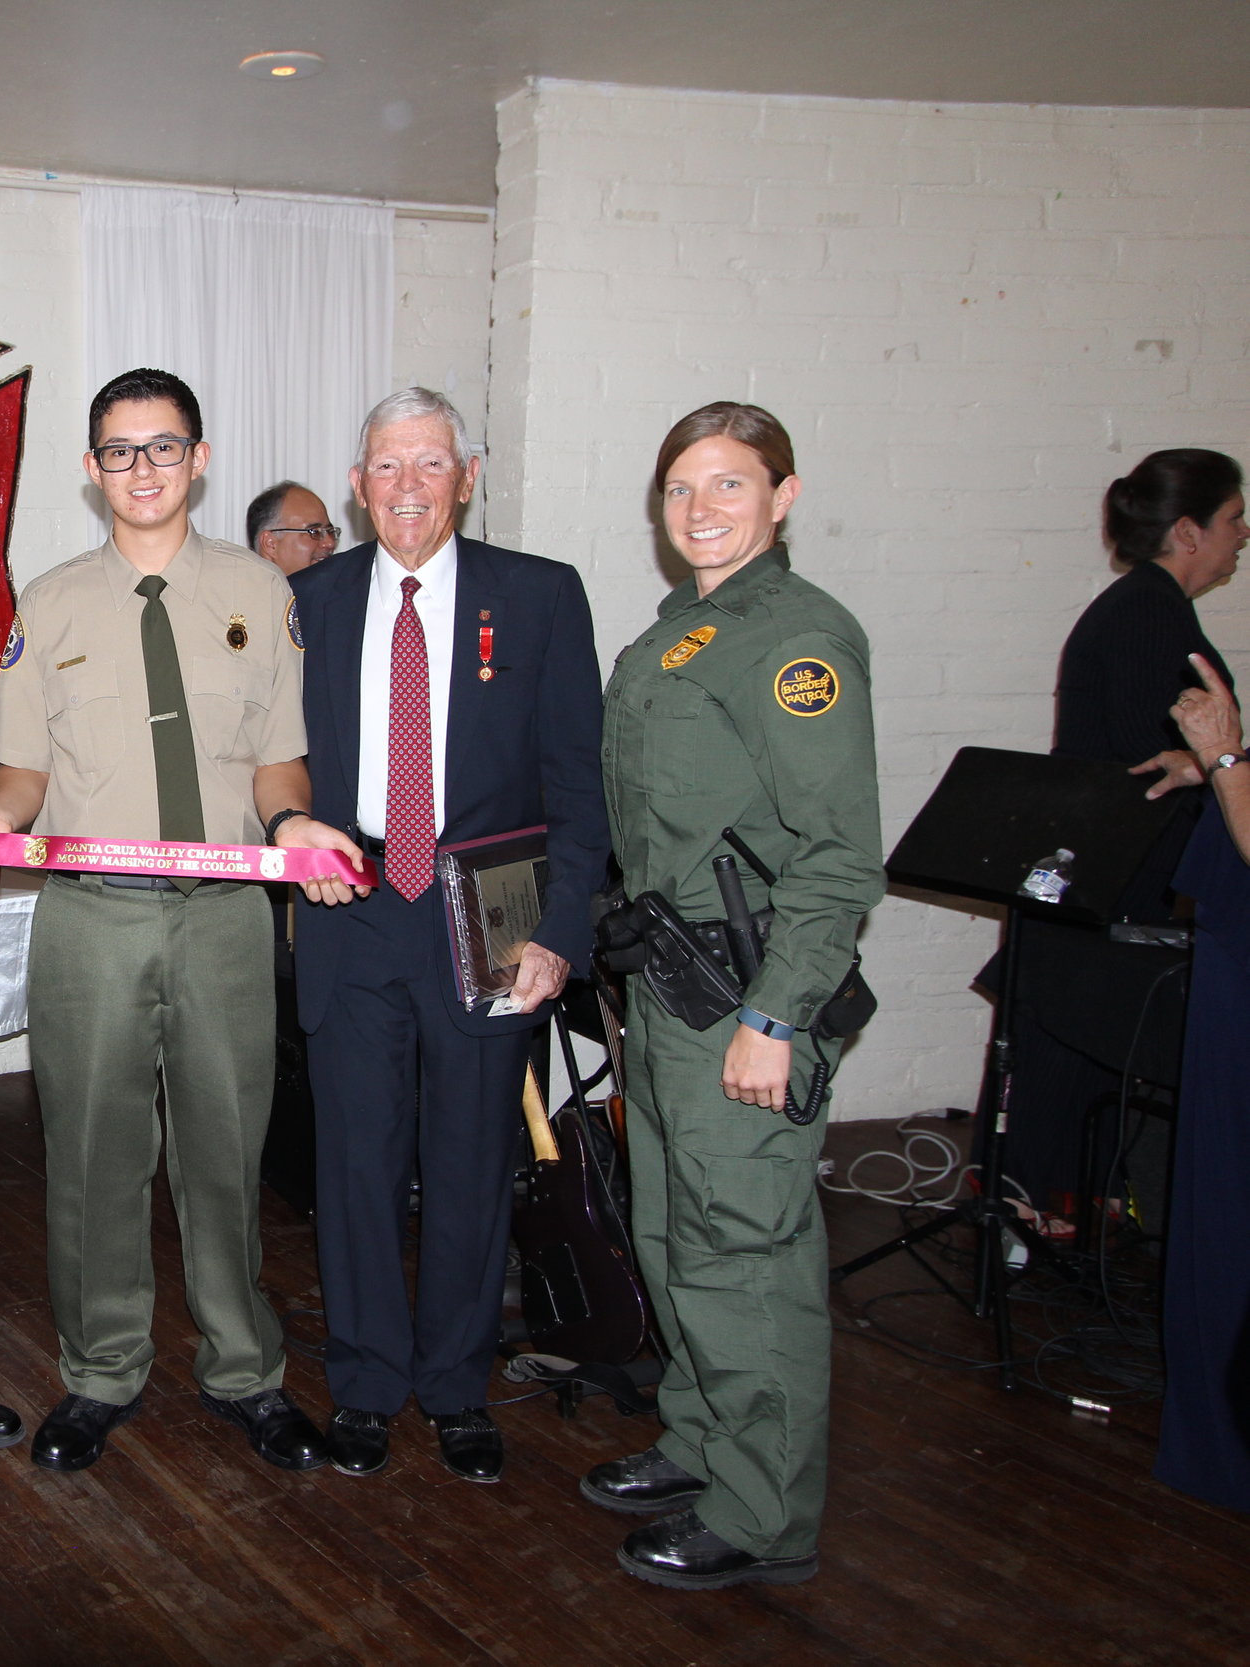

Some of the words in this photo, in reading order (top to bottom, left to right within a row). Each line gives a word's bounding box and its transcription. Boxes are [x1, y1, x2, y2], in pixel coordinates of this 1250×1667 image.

[794, 669, 815, 680] U.S.
[783, 680, 829, 694] BORDER
[786, 689, 831, 704] PATROL
[64, 842, 103, 854] SANTA
[104, 844, 137, 855] CRUZ
[138, 846, 185, 858] VALLEY
[186, 848, 244, 861] CHAPTER
[56, 854, 100, 865] MOWW
[101, 856, 154, 868] MASSING
[157, 859, 174, 869] OF
[175, 860, 199, 870] THE
[201, 861, 251, 873] COLORS
